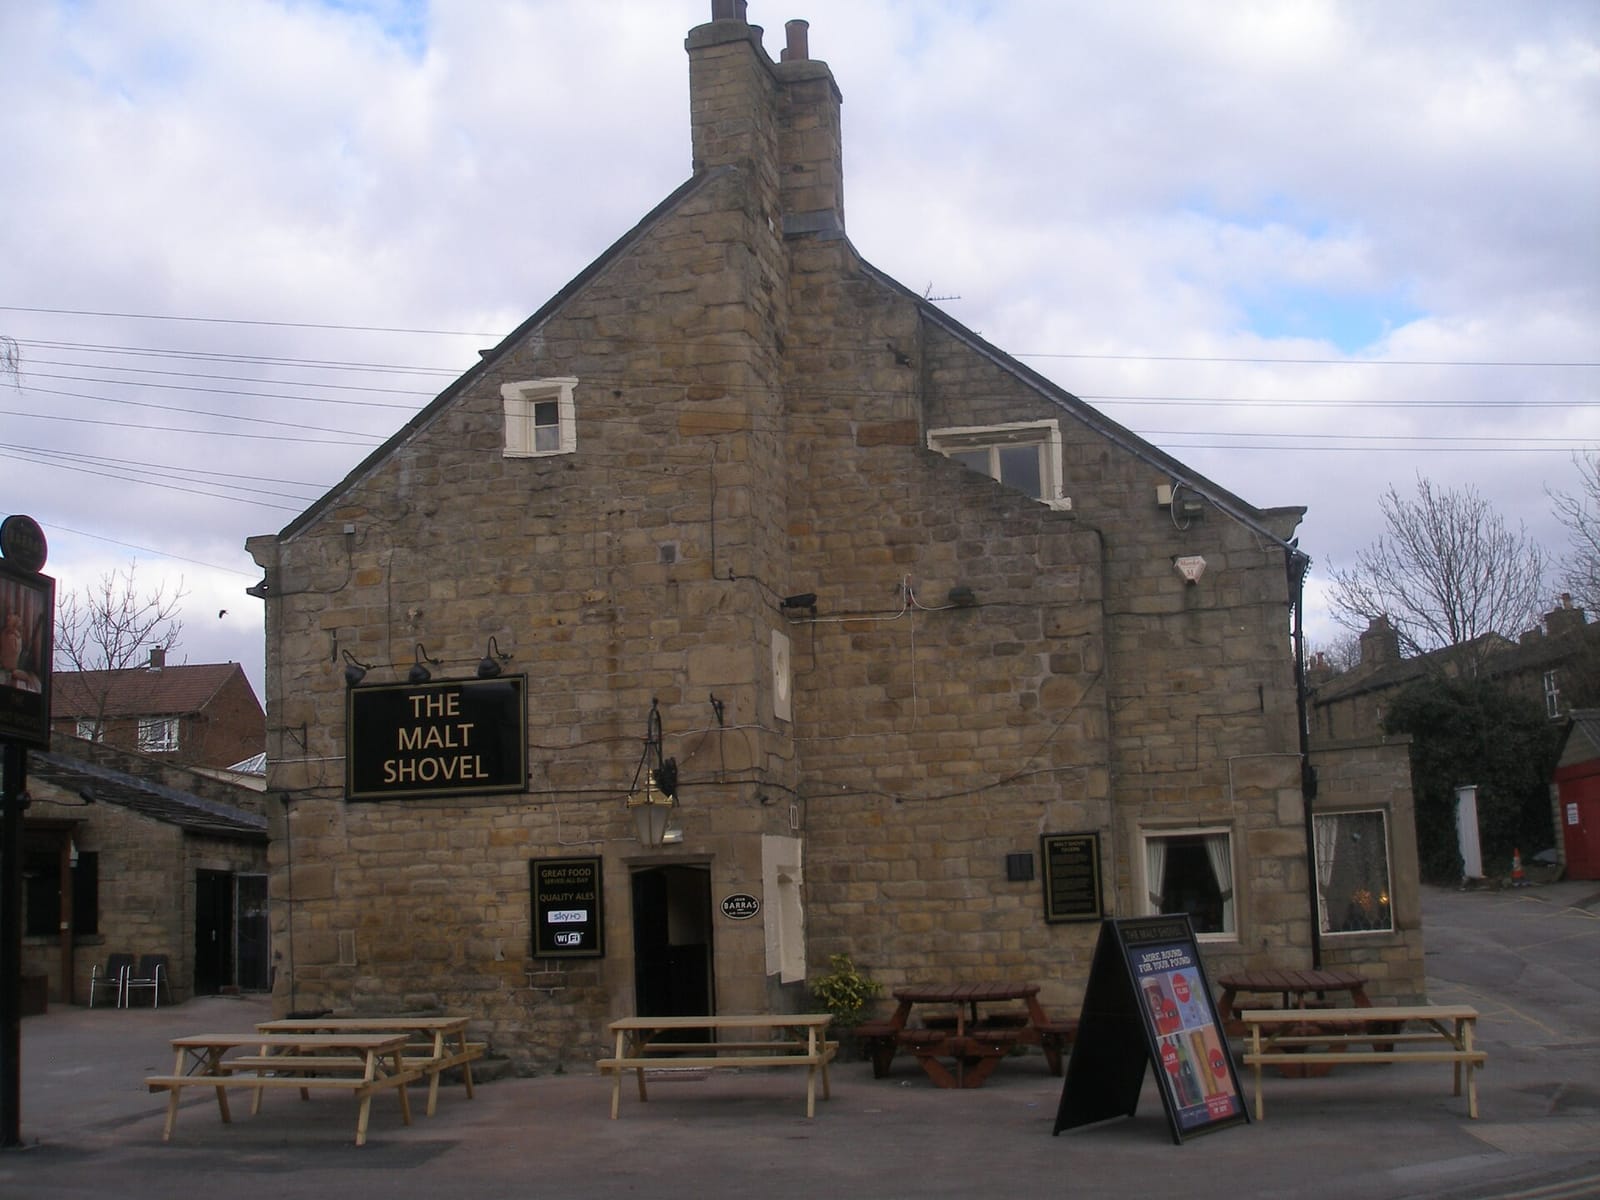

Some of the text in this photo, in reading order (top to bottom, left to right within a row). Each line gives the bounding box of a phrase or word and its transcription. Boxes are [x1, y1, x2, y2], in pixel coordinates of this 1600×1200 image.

[409, 693, 460, 718] THE
[398, 723, 474, 750] MALT
[383, 755, 489, 783] SHOVEL
[541, 868, 591, 878] GREAT FOOD
[540, 891, 594, 902] QUALITY ALES
[723, 901, 757, 910] BARRAS
